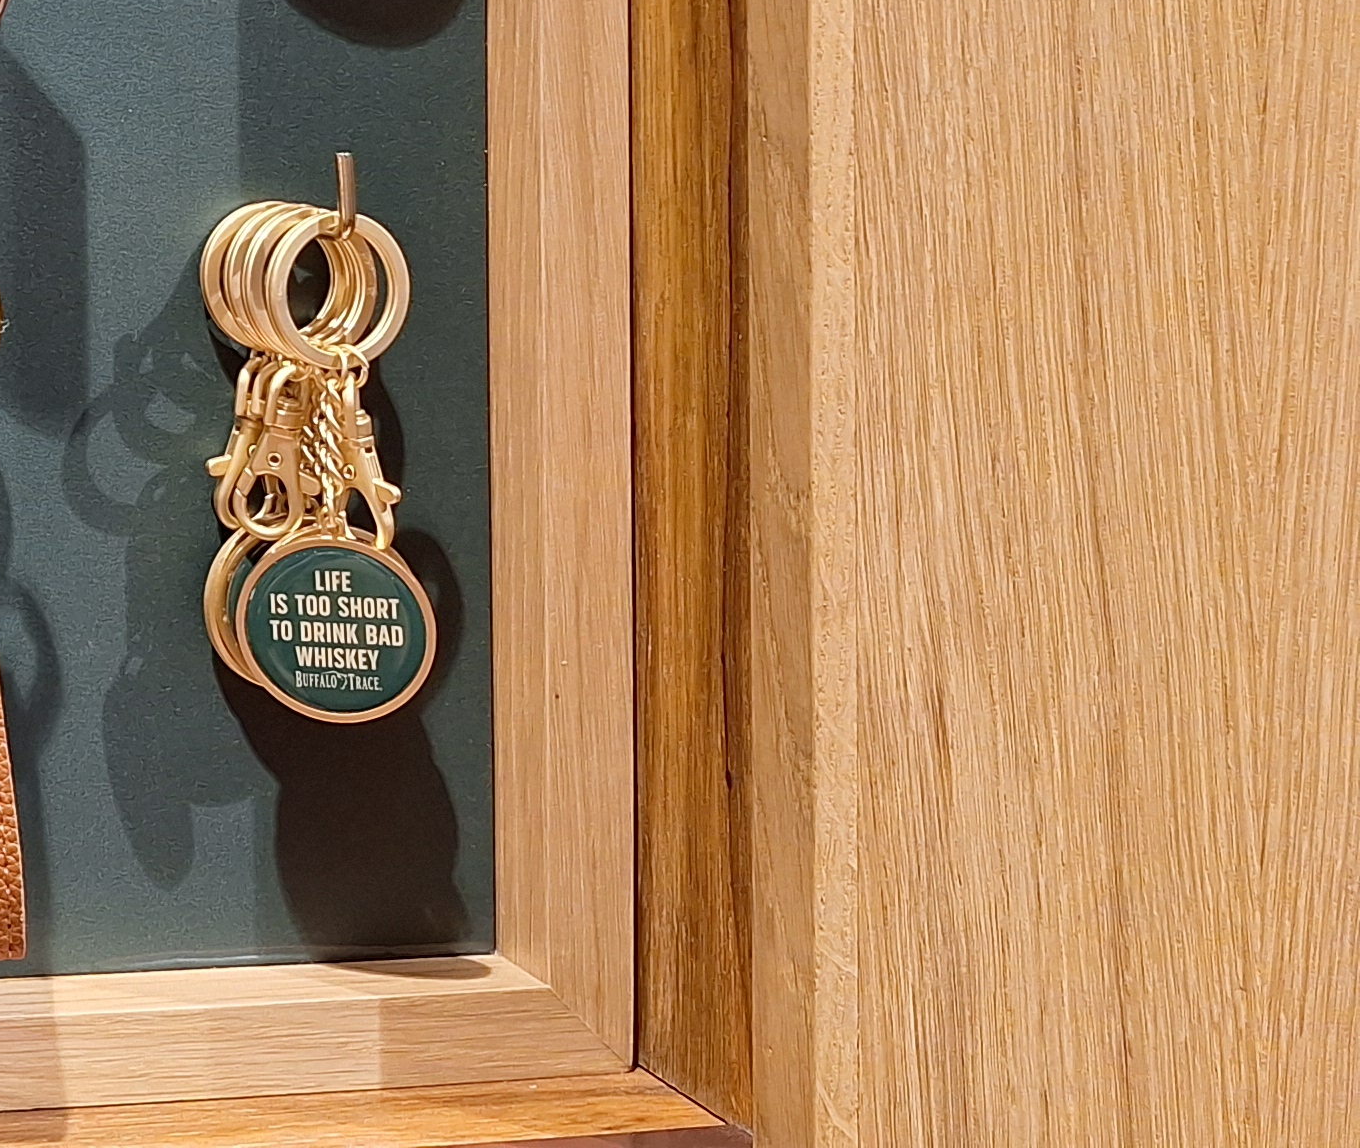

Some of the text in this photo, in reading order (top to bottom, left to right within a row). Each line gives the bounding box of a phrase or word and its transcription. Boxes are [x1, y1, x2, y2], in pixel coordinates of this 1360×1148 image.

[315, 571, 352, 592] LIFE
[270, 594, 399, 619] IS TOO SHORT
[269, 620, 404, 646] TO DRINK BAD
[295, 646, 379, 670] WHISKEY
[296, 671, 337, 688] BUFFALO
